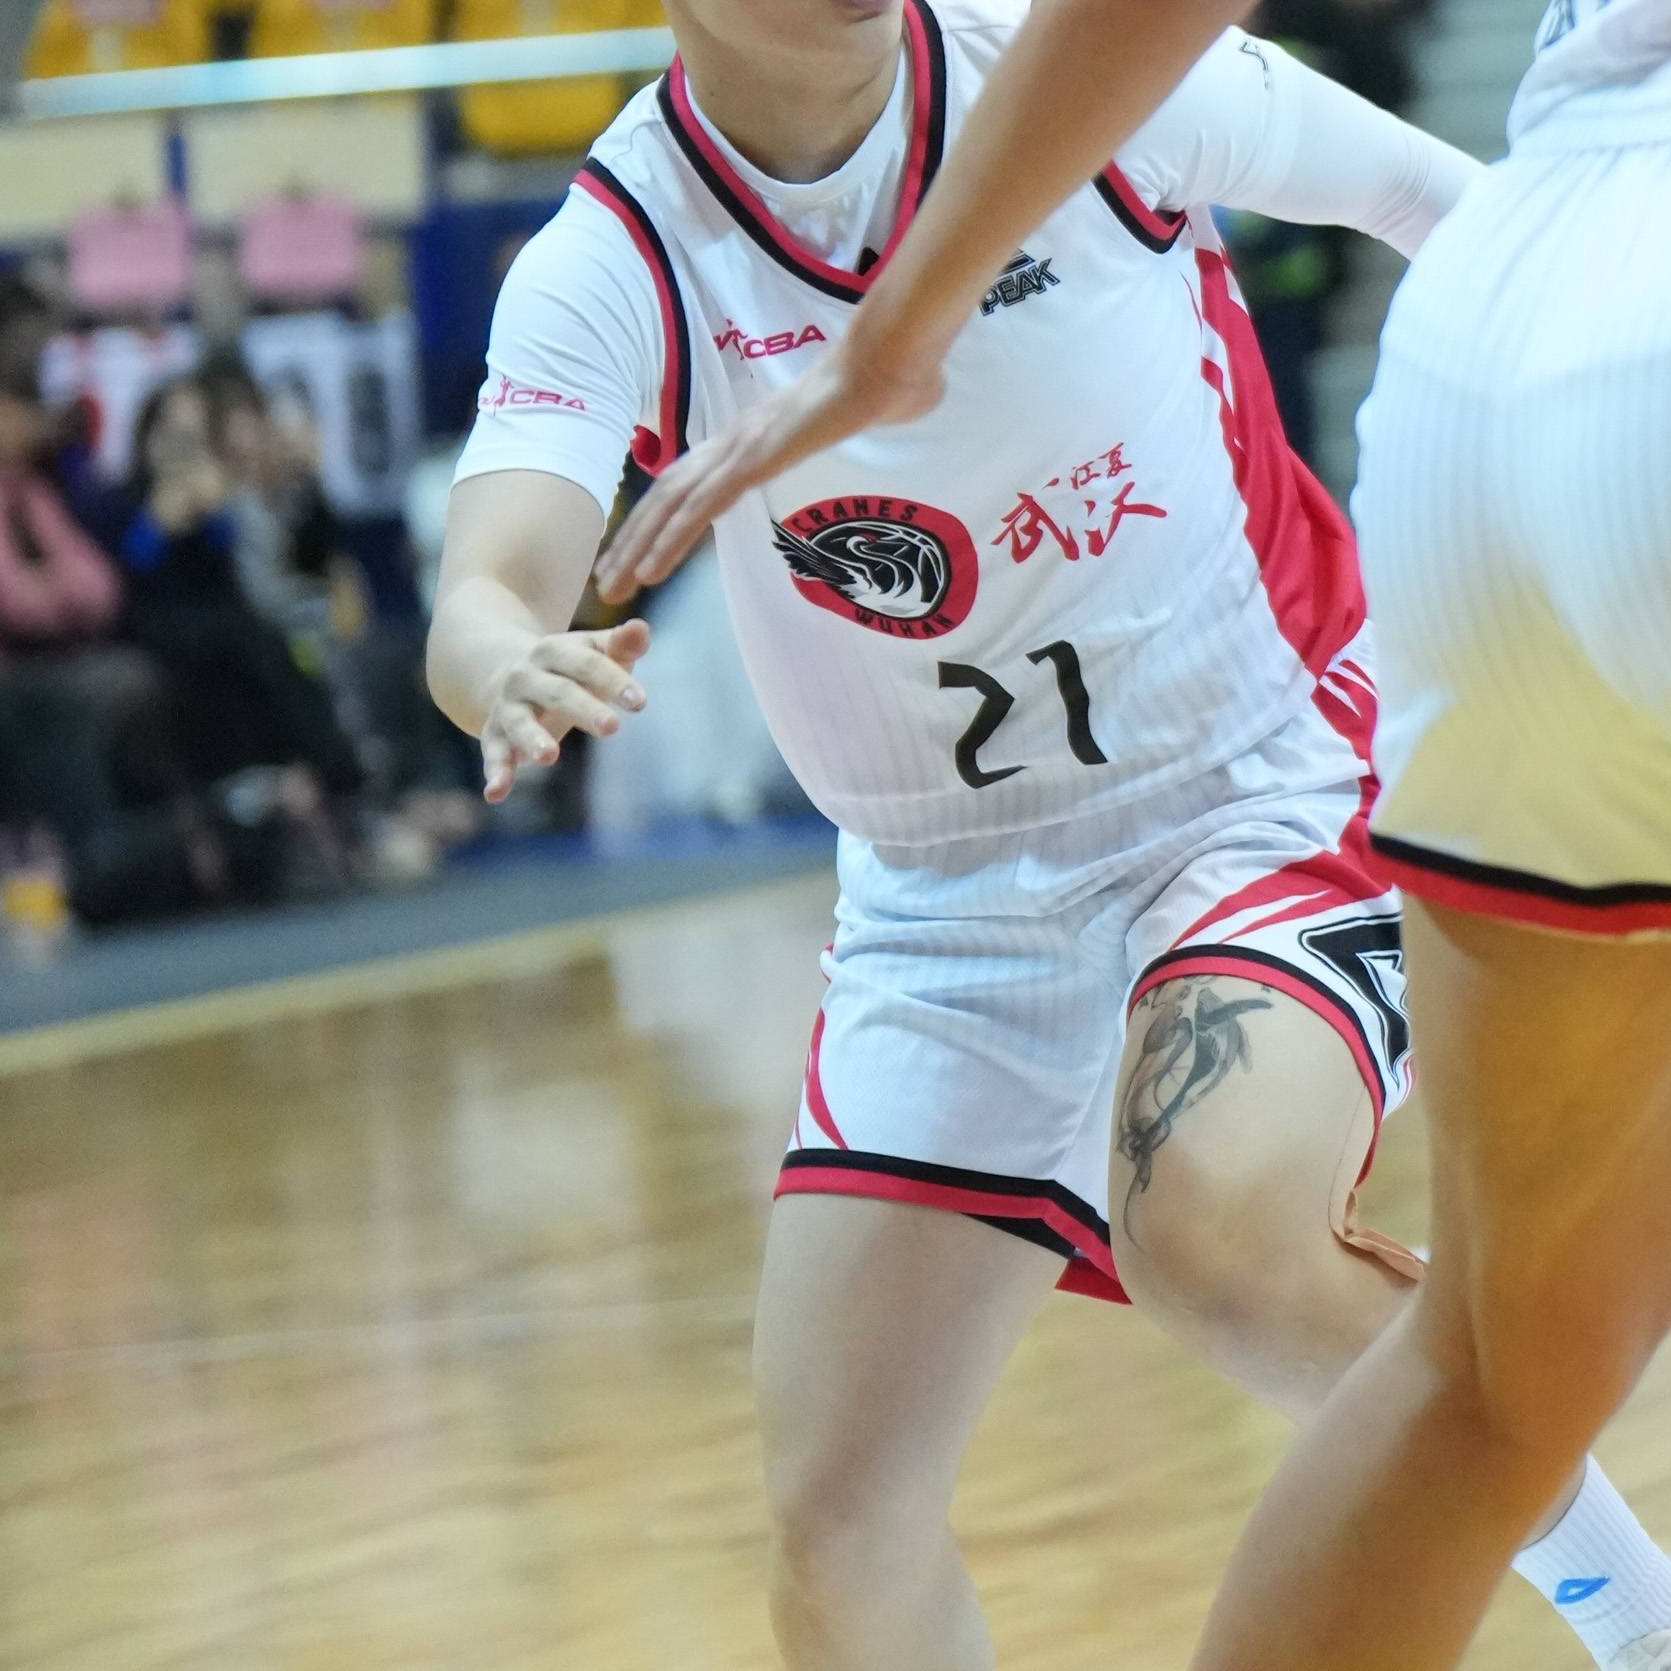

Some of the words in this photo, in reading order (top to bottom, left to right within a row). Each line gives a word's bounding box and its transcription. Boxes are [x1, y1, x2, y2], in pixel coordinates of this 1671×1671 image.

[979, 257, 1061, 317] PEAK
[791, 498, 918, 533] CRANES
[990, 477, 1167, 564] 武汉
[937, 639, 1109, 790] 21
